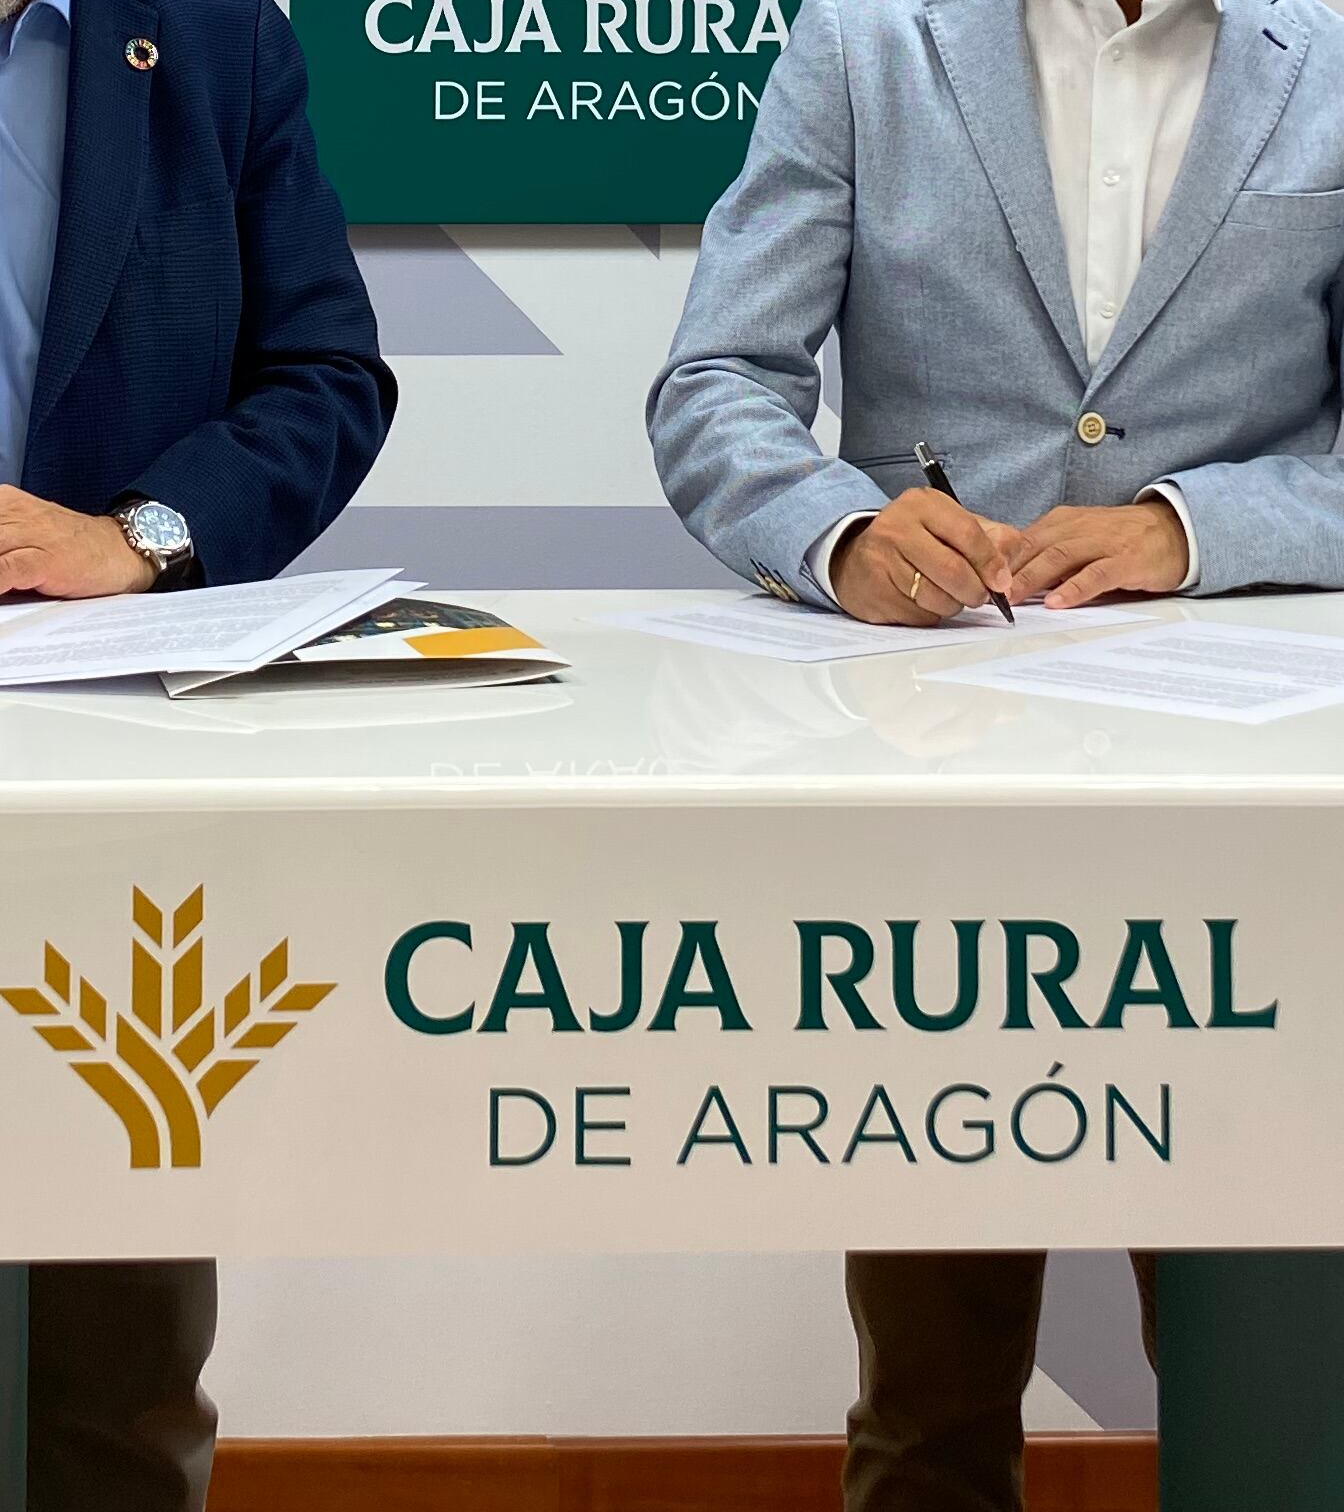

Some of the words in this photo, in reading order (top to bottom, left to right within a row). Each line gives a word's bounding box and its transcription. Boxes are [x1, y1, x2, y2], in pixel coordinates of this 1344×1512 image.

[434, 81, 506, 120] DE
[384, 920, 753, 1036] CAJA
[793, 918, 1279, 1032] RURAL
[488, 1086, 632, 1167] DE
[676, 1061, 1173, 1166] ARAGÓN
